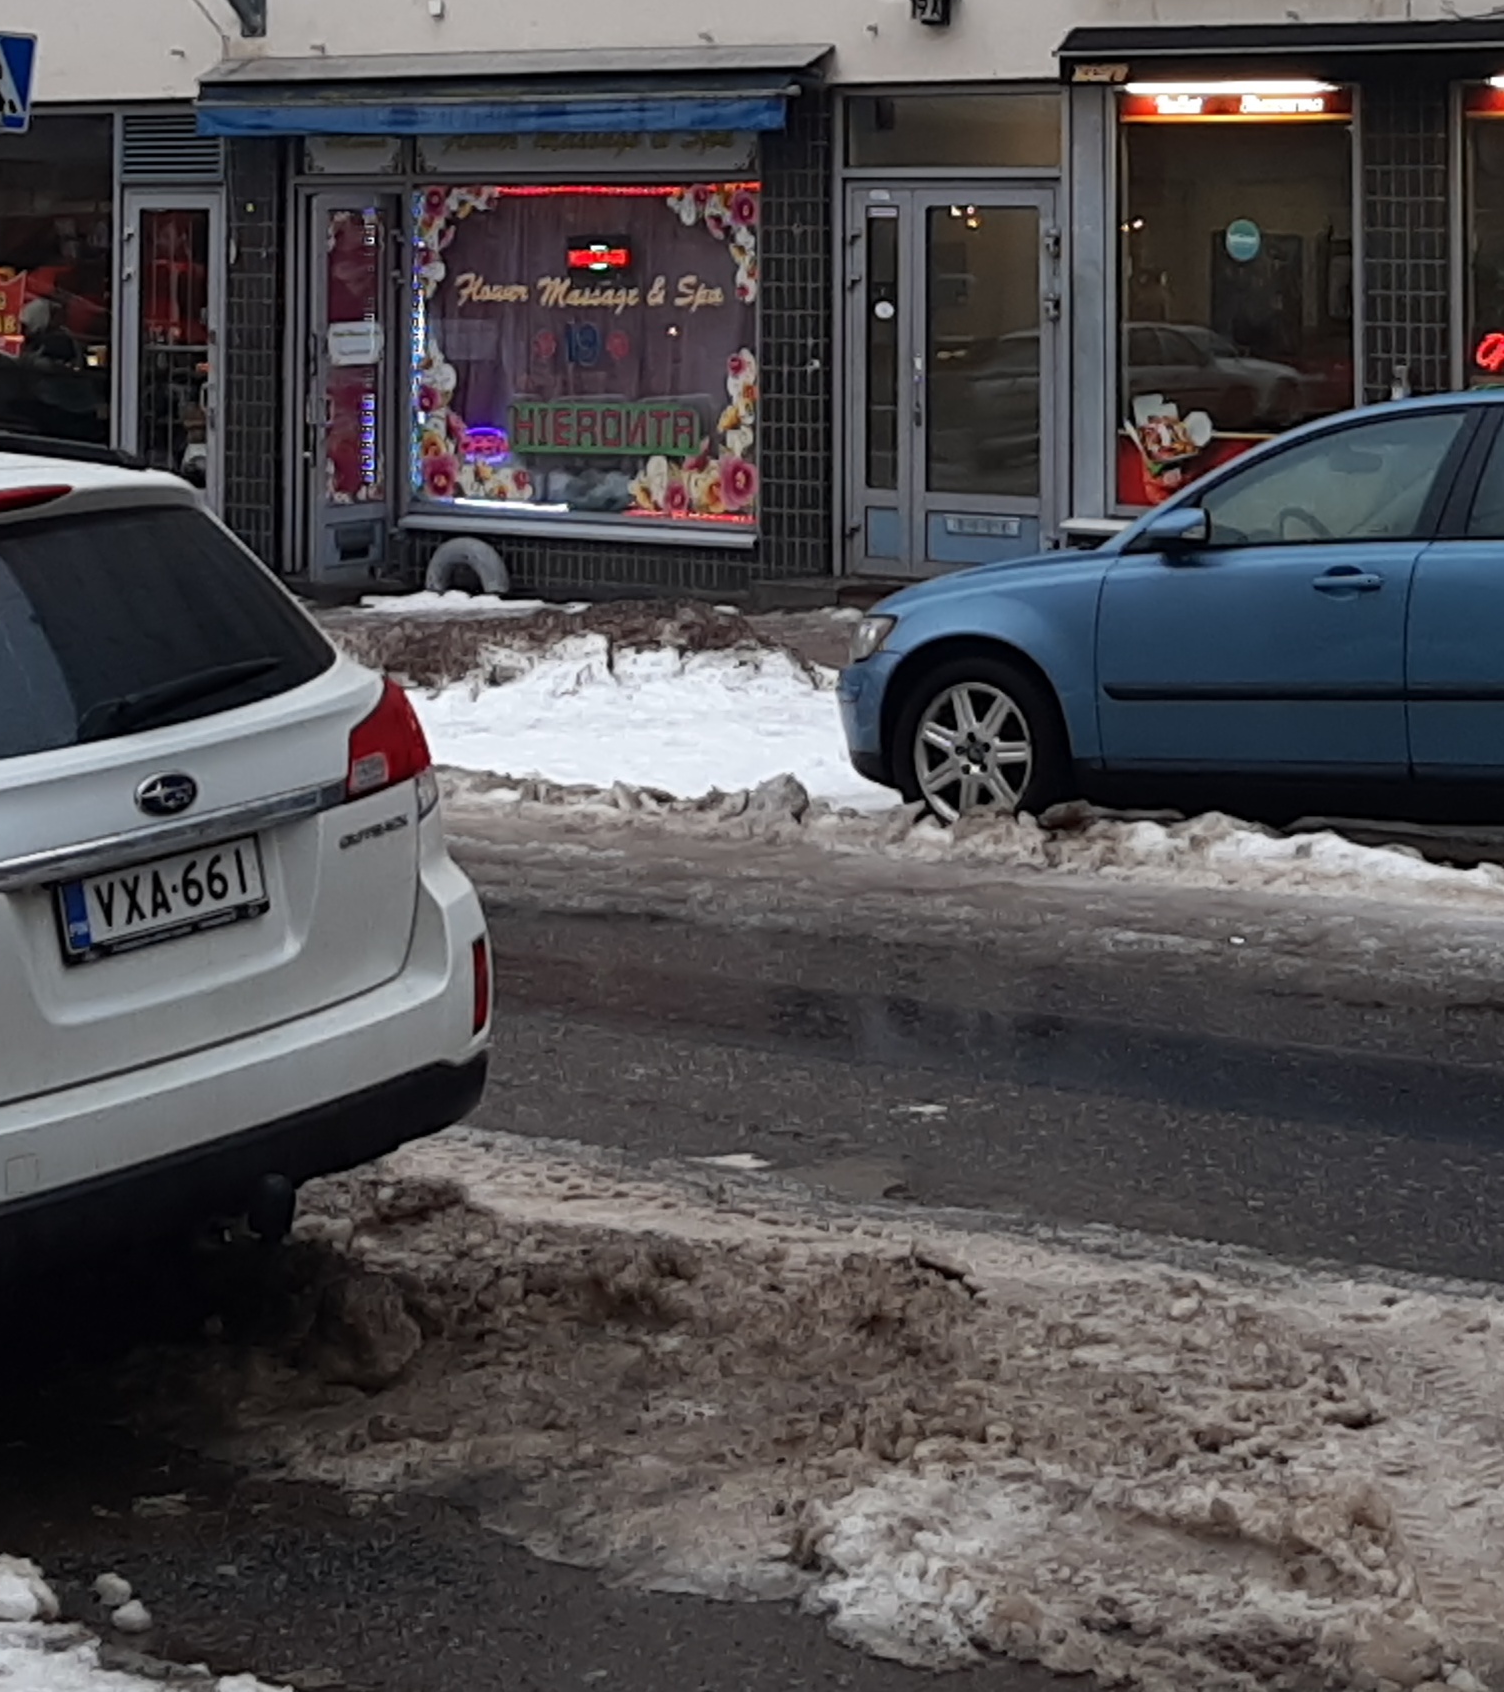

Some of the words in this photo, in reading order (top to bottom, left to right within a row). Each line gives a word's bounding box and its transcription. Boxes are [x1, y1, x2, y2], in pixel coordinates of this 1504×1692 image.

[537, 276, 640, 315] Massage
[674, 275, 724, 313] Spa
[94, 847, 247, 928] VXA-661
